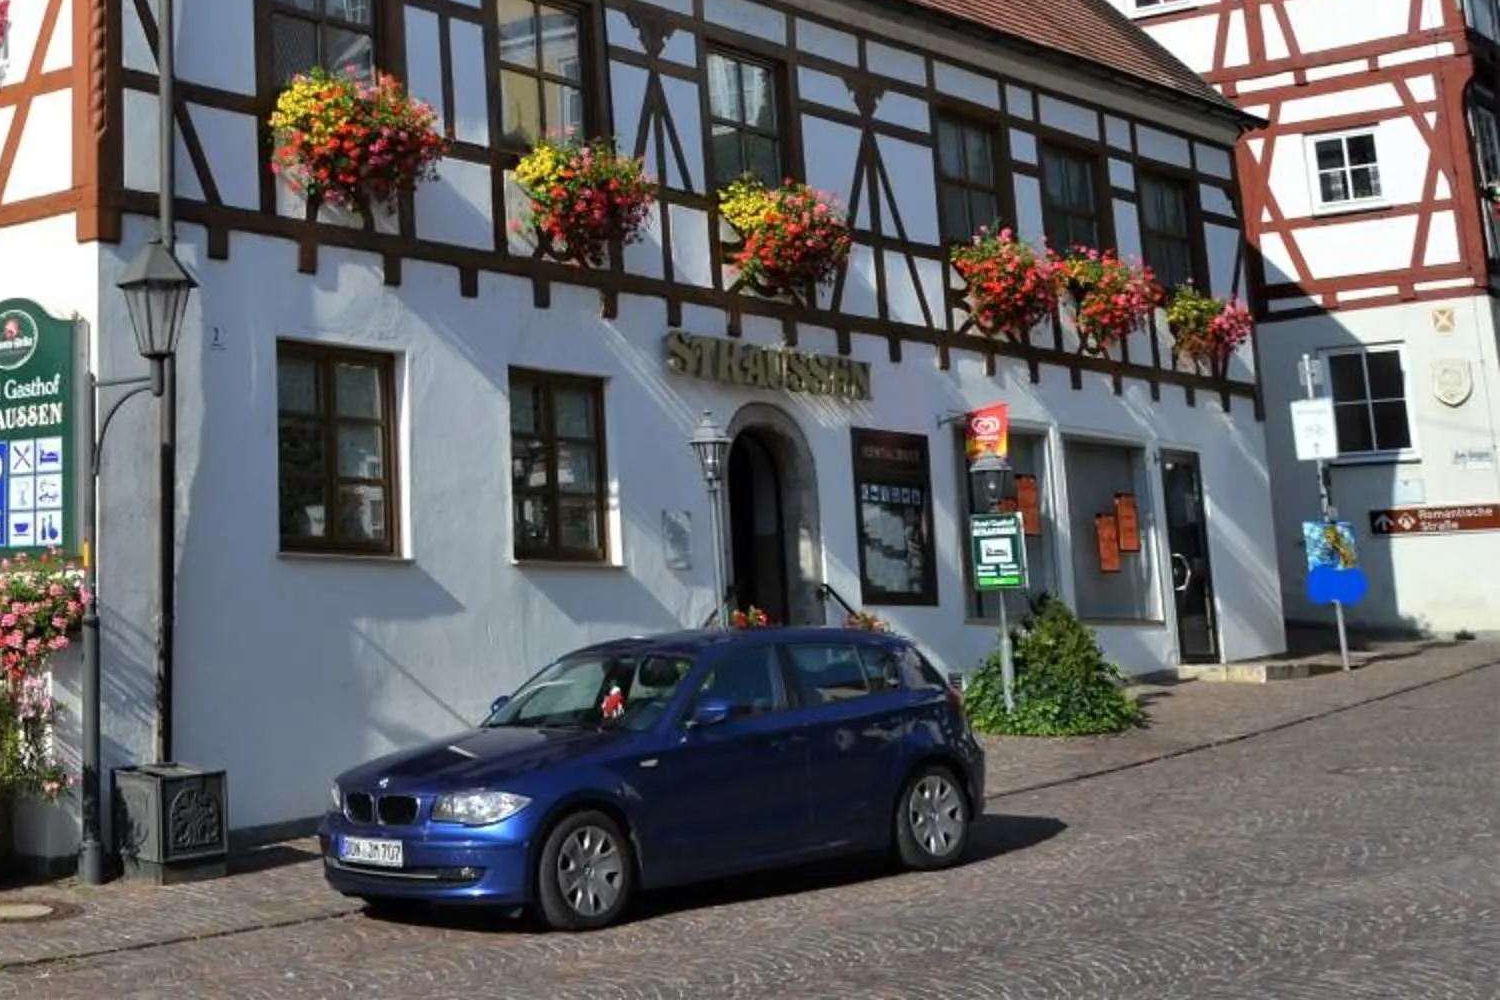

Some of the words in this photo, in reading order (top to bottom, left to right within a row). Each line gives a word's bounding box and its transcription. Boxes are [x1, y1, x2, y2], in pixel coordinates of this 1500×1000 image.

[665, 331, 873, 400] STRAUSSEN
[4, 373, 60, 399] Gasthof
[1418, 508, 1493, 520] Romantische
